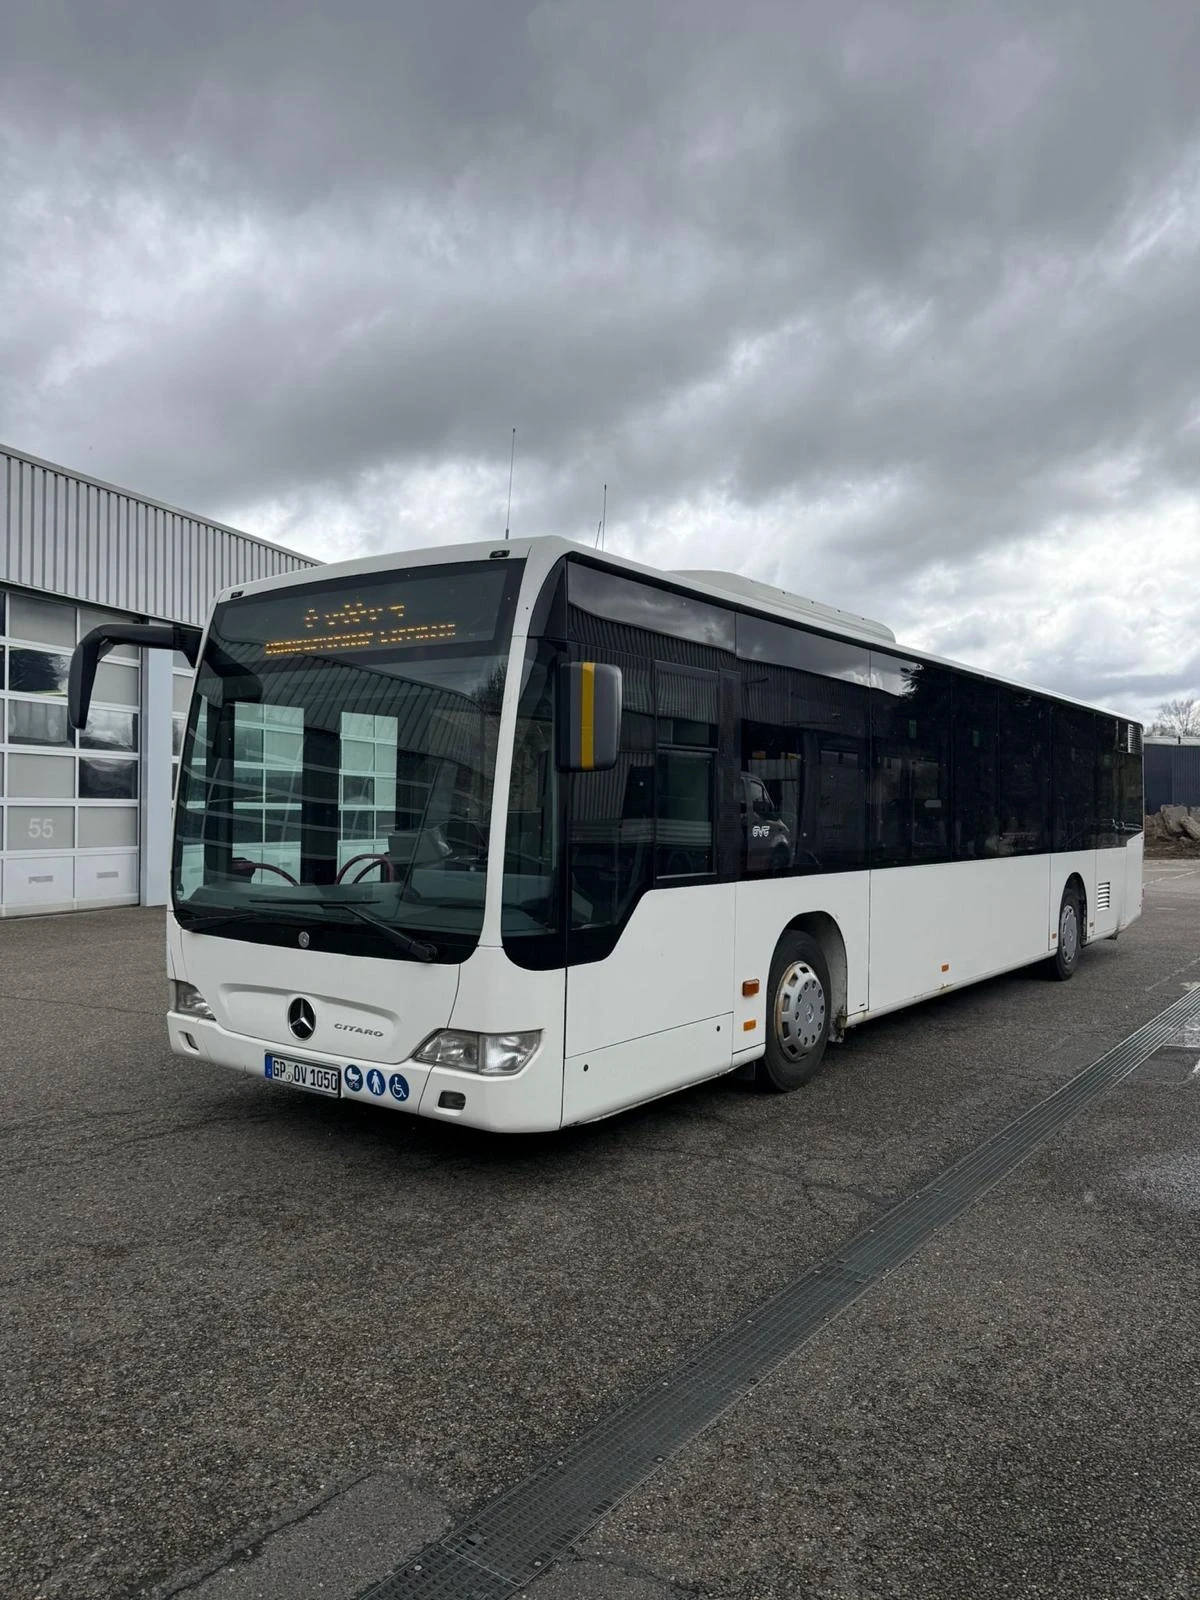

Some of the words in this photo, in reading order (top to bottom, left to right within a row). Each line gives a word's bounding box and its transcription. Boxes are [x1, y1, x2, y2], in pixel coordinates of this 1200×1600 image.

[28, 818, 54, 838] 55
[334, 1023, 384, 1037] CITARO
[273, 1060, 286, 1078] GP
[294, 1065, 307, 1084] OV
[310, 1069, 338, 1091] 1050
